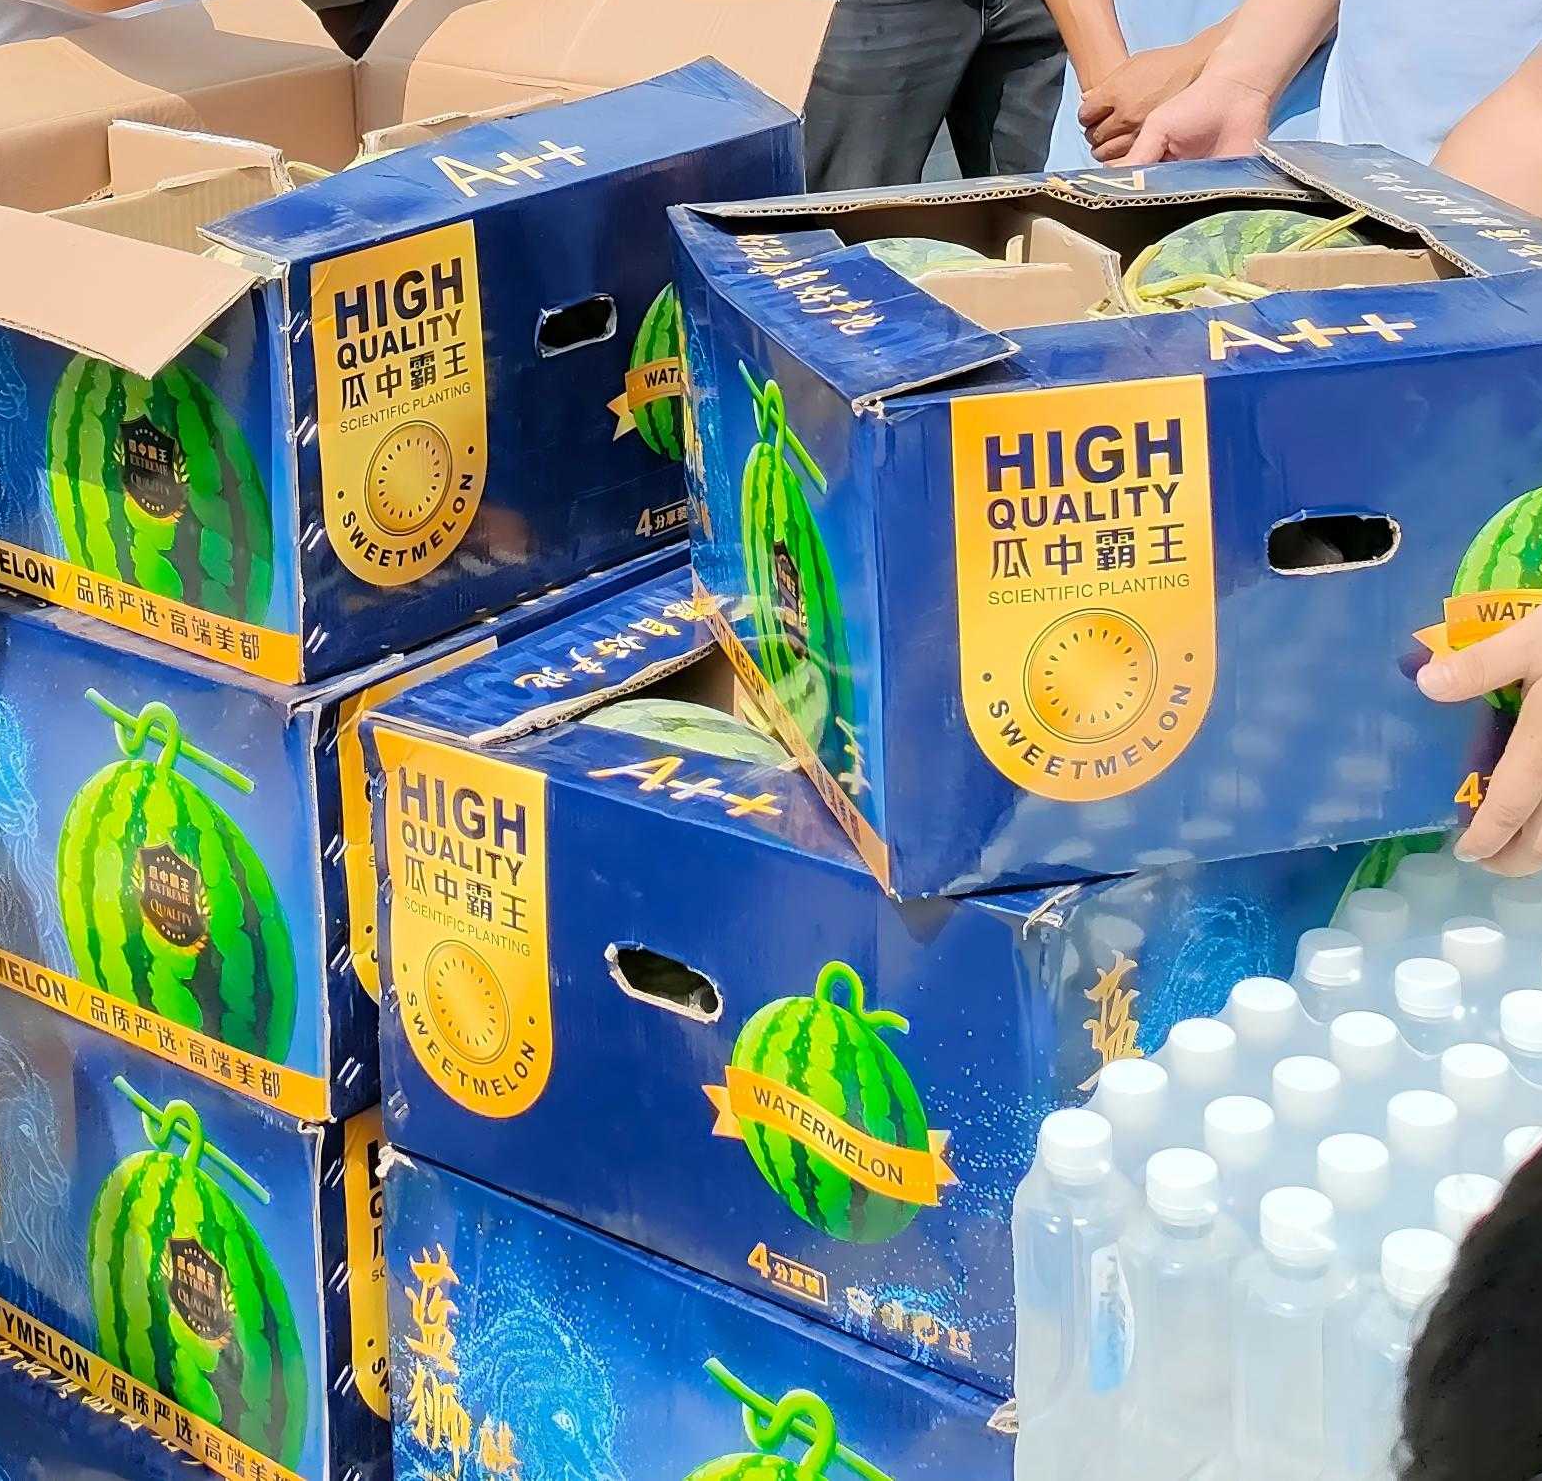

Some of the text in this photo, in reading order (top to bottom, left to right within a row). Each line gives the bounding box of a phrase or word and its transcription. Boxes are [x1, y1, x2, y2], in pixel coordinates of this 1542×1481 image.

[432, 140, 587, 198] A++
[333, 256, 465, 340] HIGH
[337, 309, 463, 370] QUALITY
[1208, 313, 1417, 361] A++
[339, 381, 471, 434] SCIENTIFIC PLANTING
[340, 341, 469, 413] 瓜中霸王
[643, 367, 683, 389] WAT
[984, 417, 1184, 493] HIGH
[342, 473, 474, 568] SWEETMELON
[986, 481, 1180, 531] QUALITY
[990, 522, 1188, 580] 瓜中霸王
[76, 575, 261, 662] 品质严选·高端美都
[987, 573, 1190, 606] SCIENTIFIC PLANTING
[989, 683, 1192, 780] SWEETMELON
[399, 765, 528, 856] HIGH
[587, 756, 783, 817] A++
[400, 820, 524, 887] QUALITY
[150, 898, 192, 927] QUALITY
[404, 853, 529, 934] 瓜中霸王
[404, 895, 531, 958] SCIENTIFIC PLANTING
[89, 994, 283, 1099] 品质严选·高端美都
[406, 990, 536, 1098] SWEETMELON
[752, 1084, 904, 1187] WATERMELON
[404, 1242, 472, 1480] 蓝狮
[111, 1372, 291, 1481] 品质严选·高端美
